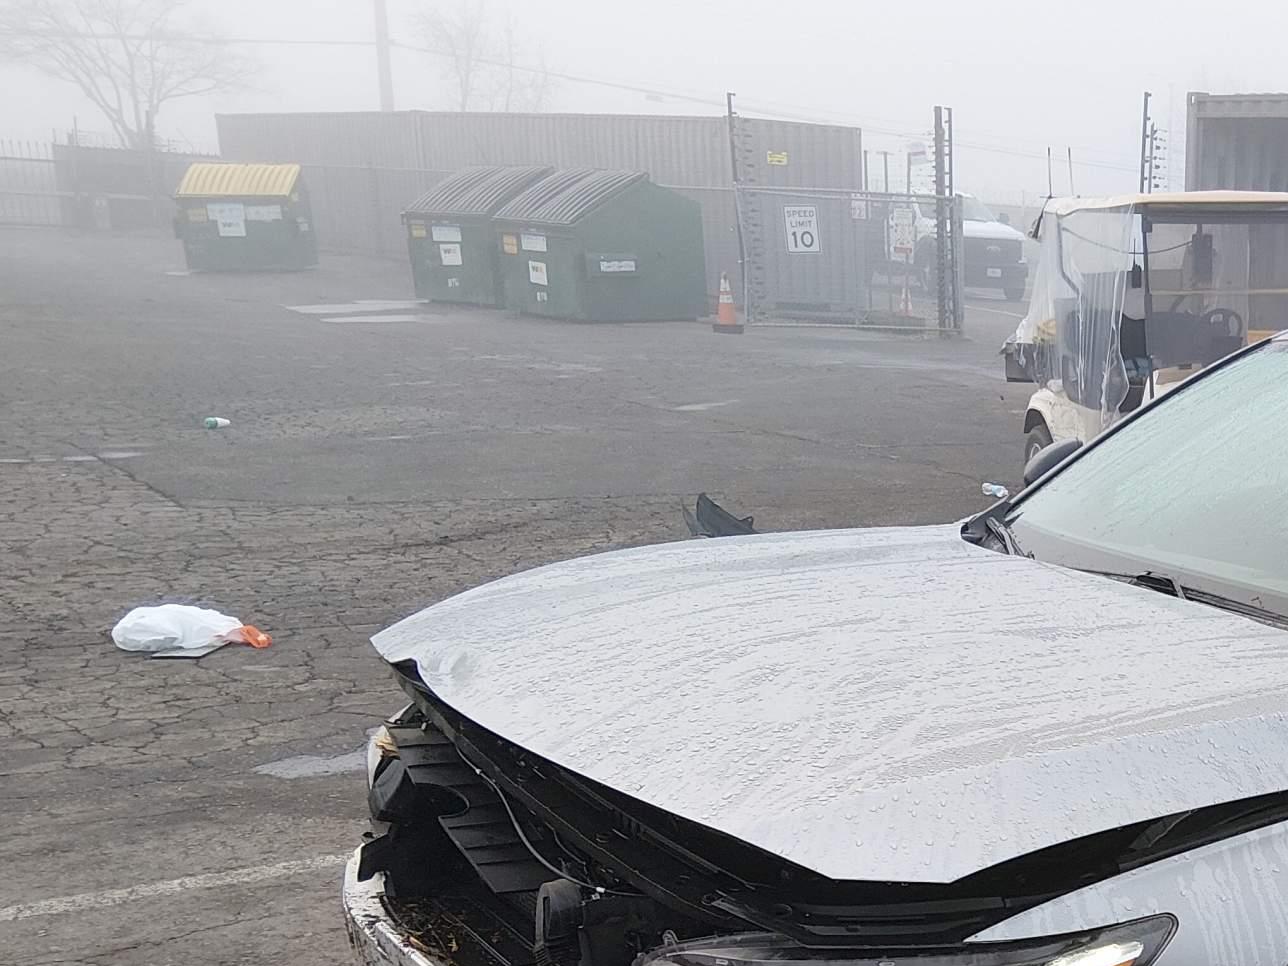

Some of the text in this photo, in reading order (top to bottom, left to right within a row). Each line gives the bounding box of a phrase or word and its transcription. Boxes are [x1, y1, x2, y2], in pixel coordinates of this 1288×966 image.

[786, 209, 814, 218] SPEED
[790, 219, 812, 228] LIMIT
[791, 230, 814, 249] 10
